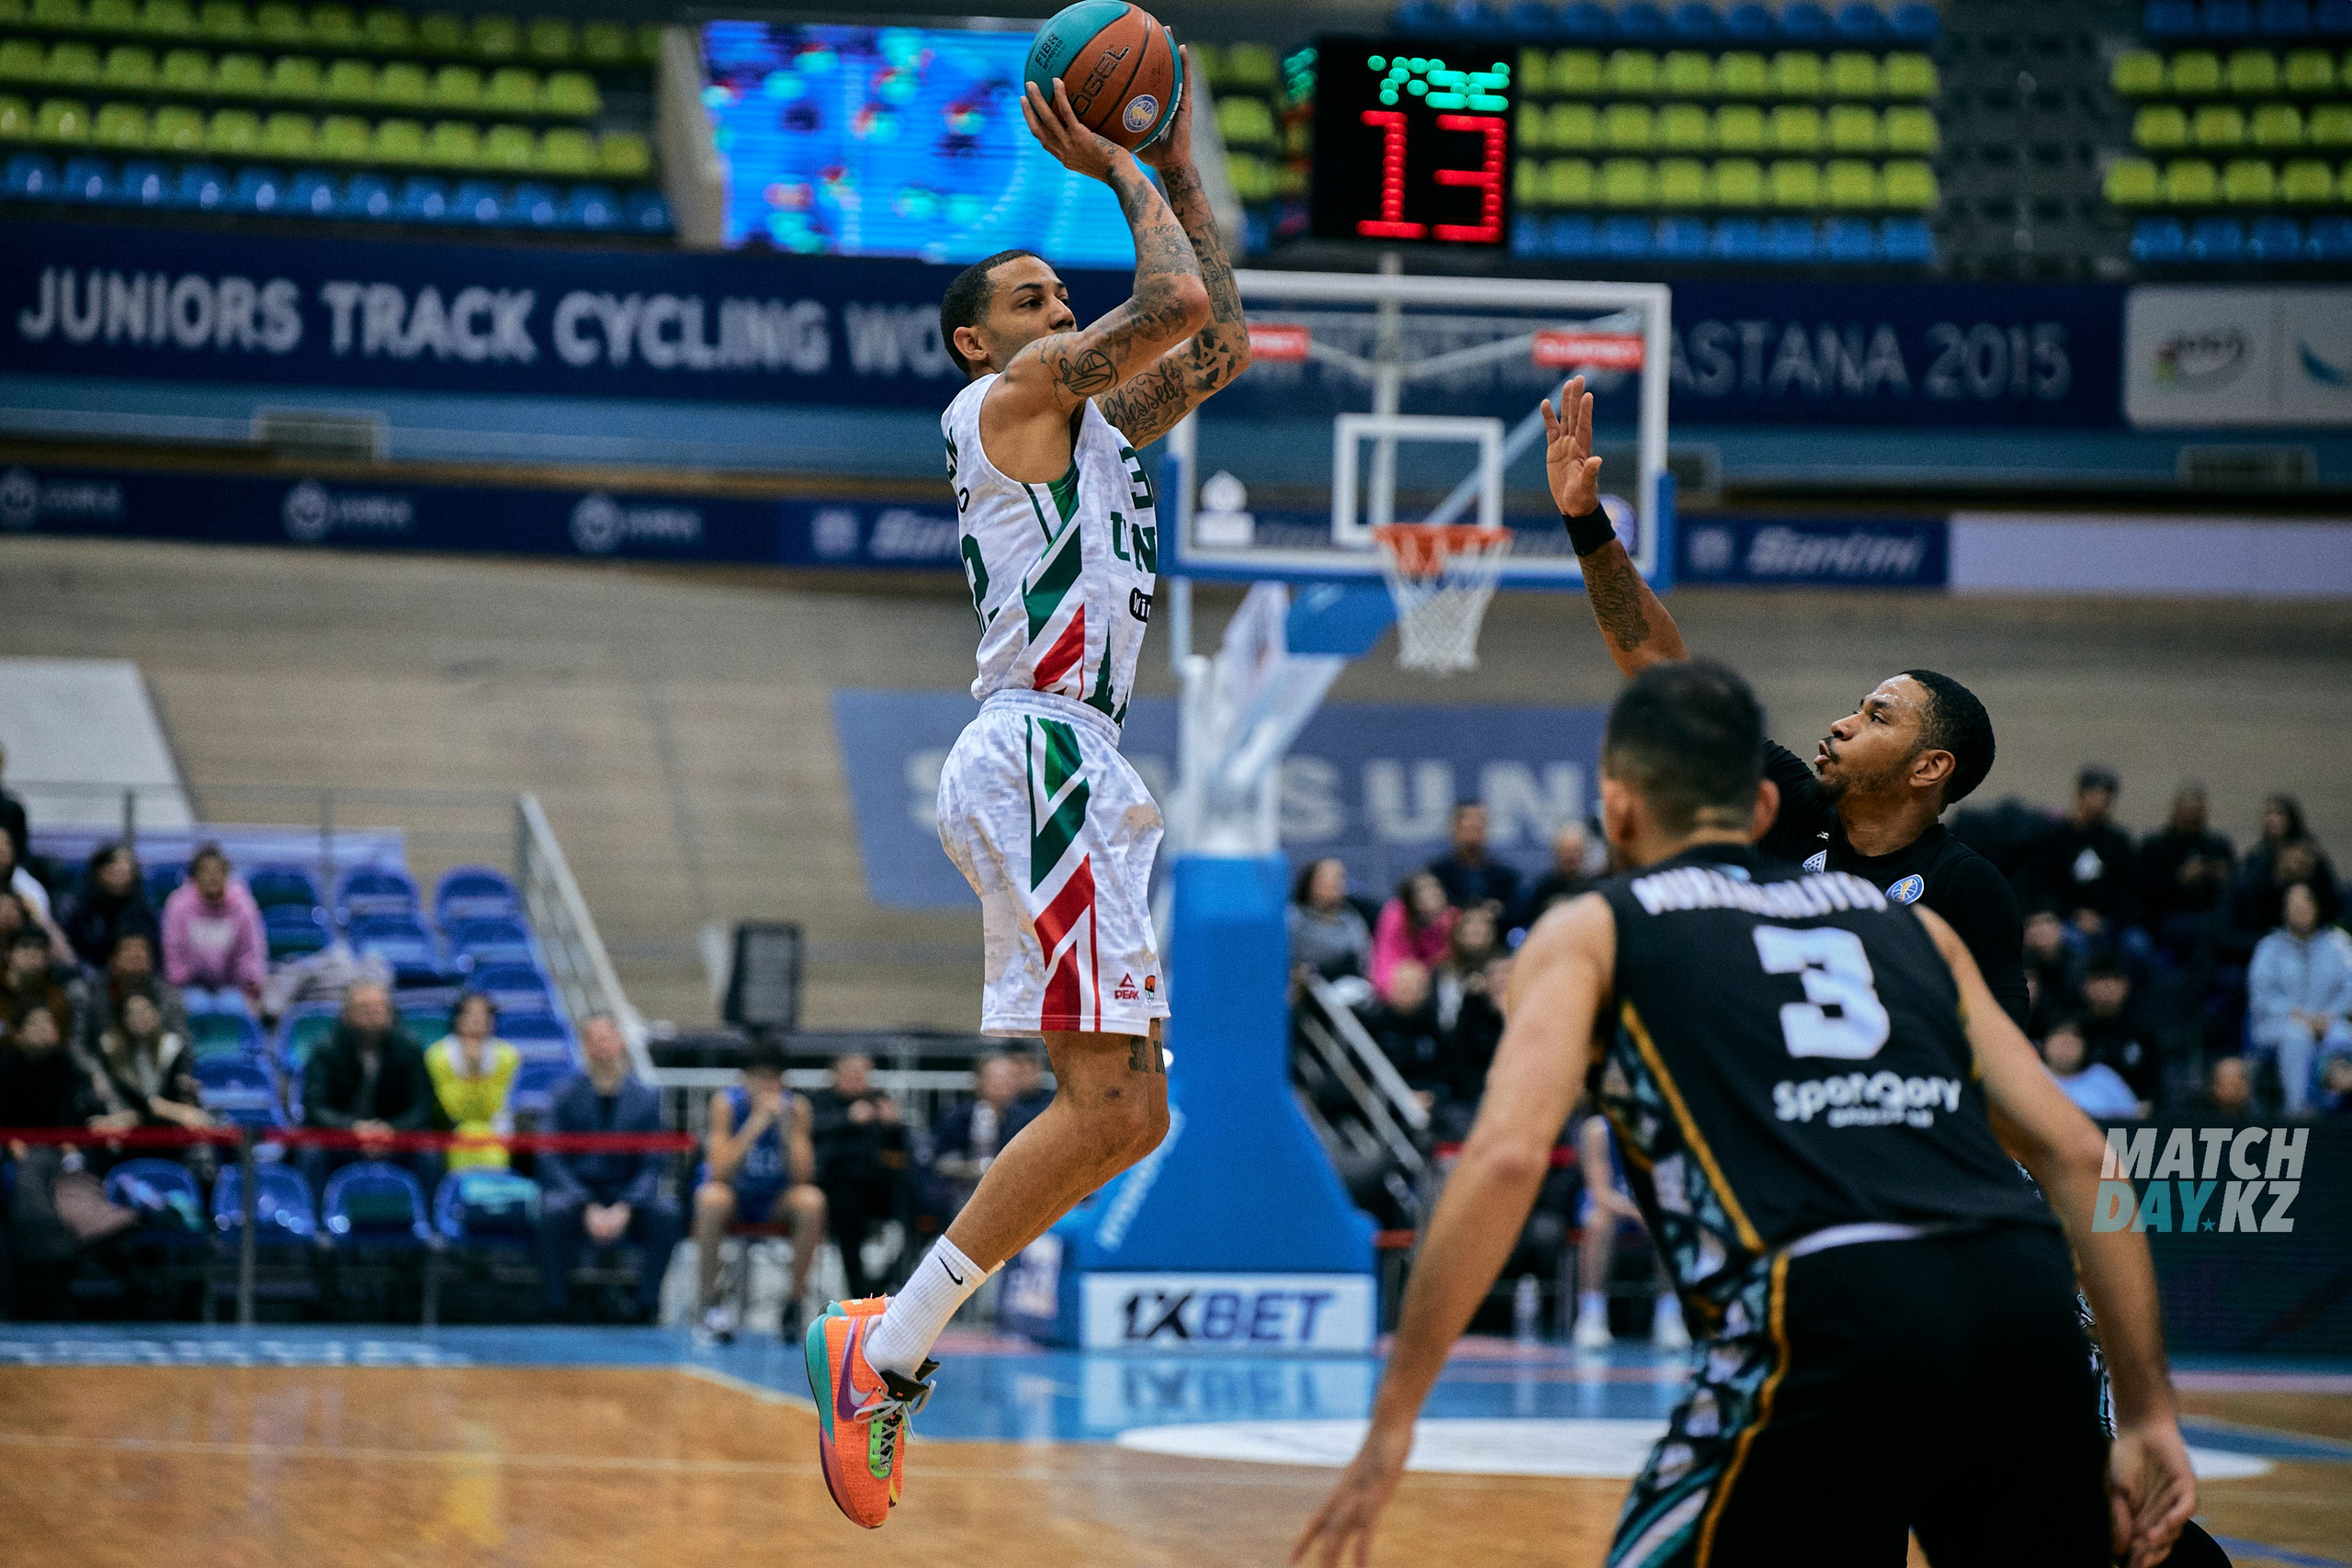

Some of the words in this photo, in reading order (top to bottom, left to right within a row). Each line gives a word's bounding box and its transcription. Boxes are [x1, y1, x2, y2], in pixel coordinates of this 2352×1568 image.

[1035, 33, 1058, 66] FIBA
[1043, 39, 1063, 70] APPROVED
[1356, 110, 1508, 243] 13
[18, 267, 302, 354] JUNIORS
[322, 279, 537, 362] TRACK
[554, 290, 829, 372] CYCLING
[1923, 322, 2074, 400] 2015
[1103, 362, 1180, 430] Blessed
[1114, 989, 1139, 1000] PEAK
[1753, 926, 1890, 1060] 3
[1125, 1292, 1331, 1341] 1XBET
